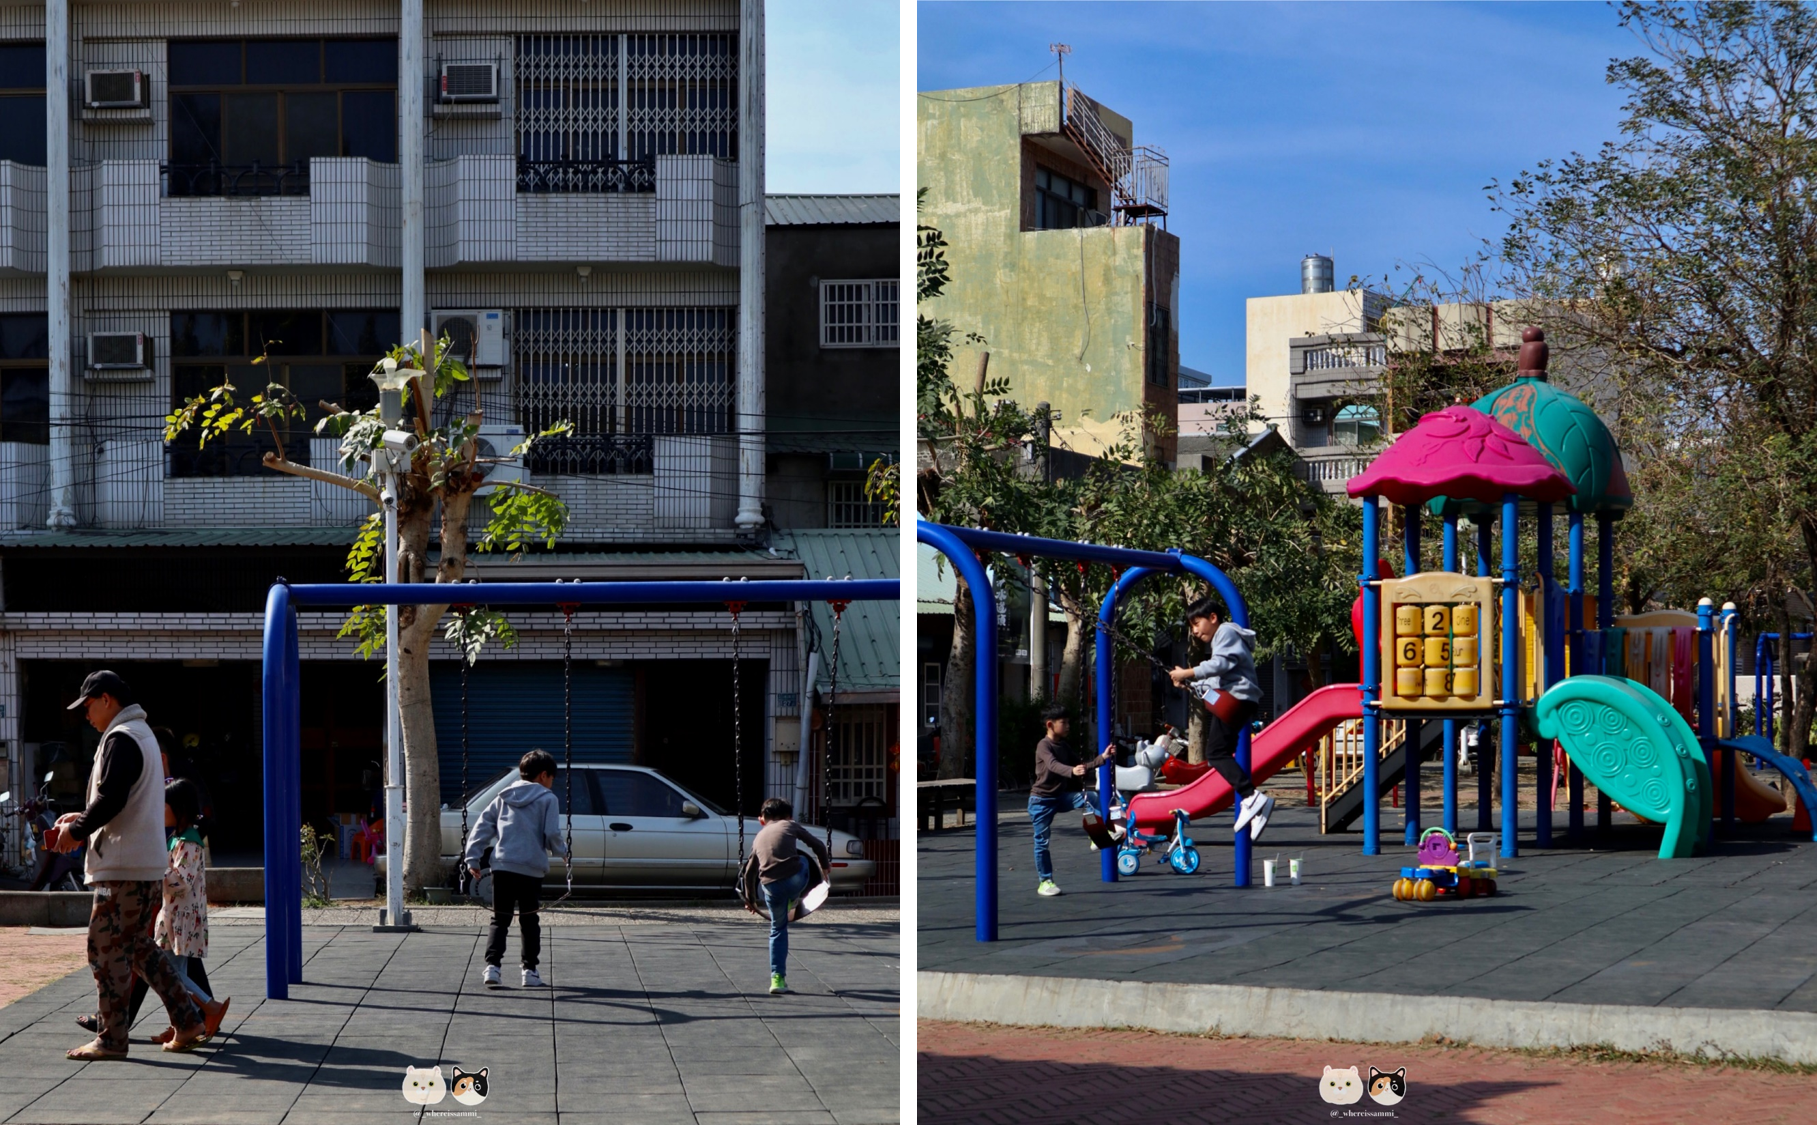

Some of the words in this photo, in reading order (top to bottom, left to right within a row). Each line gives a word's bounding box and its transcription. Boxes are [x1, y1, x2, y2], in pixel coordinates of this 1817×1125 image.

[1432, 612, 1444, 630] 2
[1456, 615, 1470, 626] One
[1404, 642, 1416, 660] 6
[1441, 642, 1450, 660] 5
